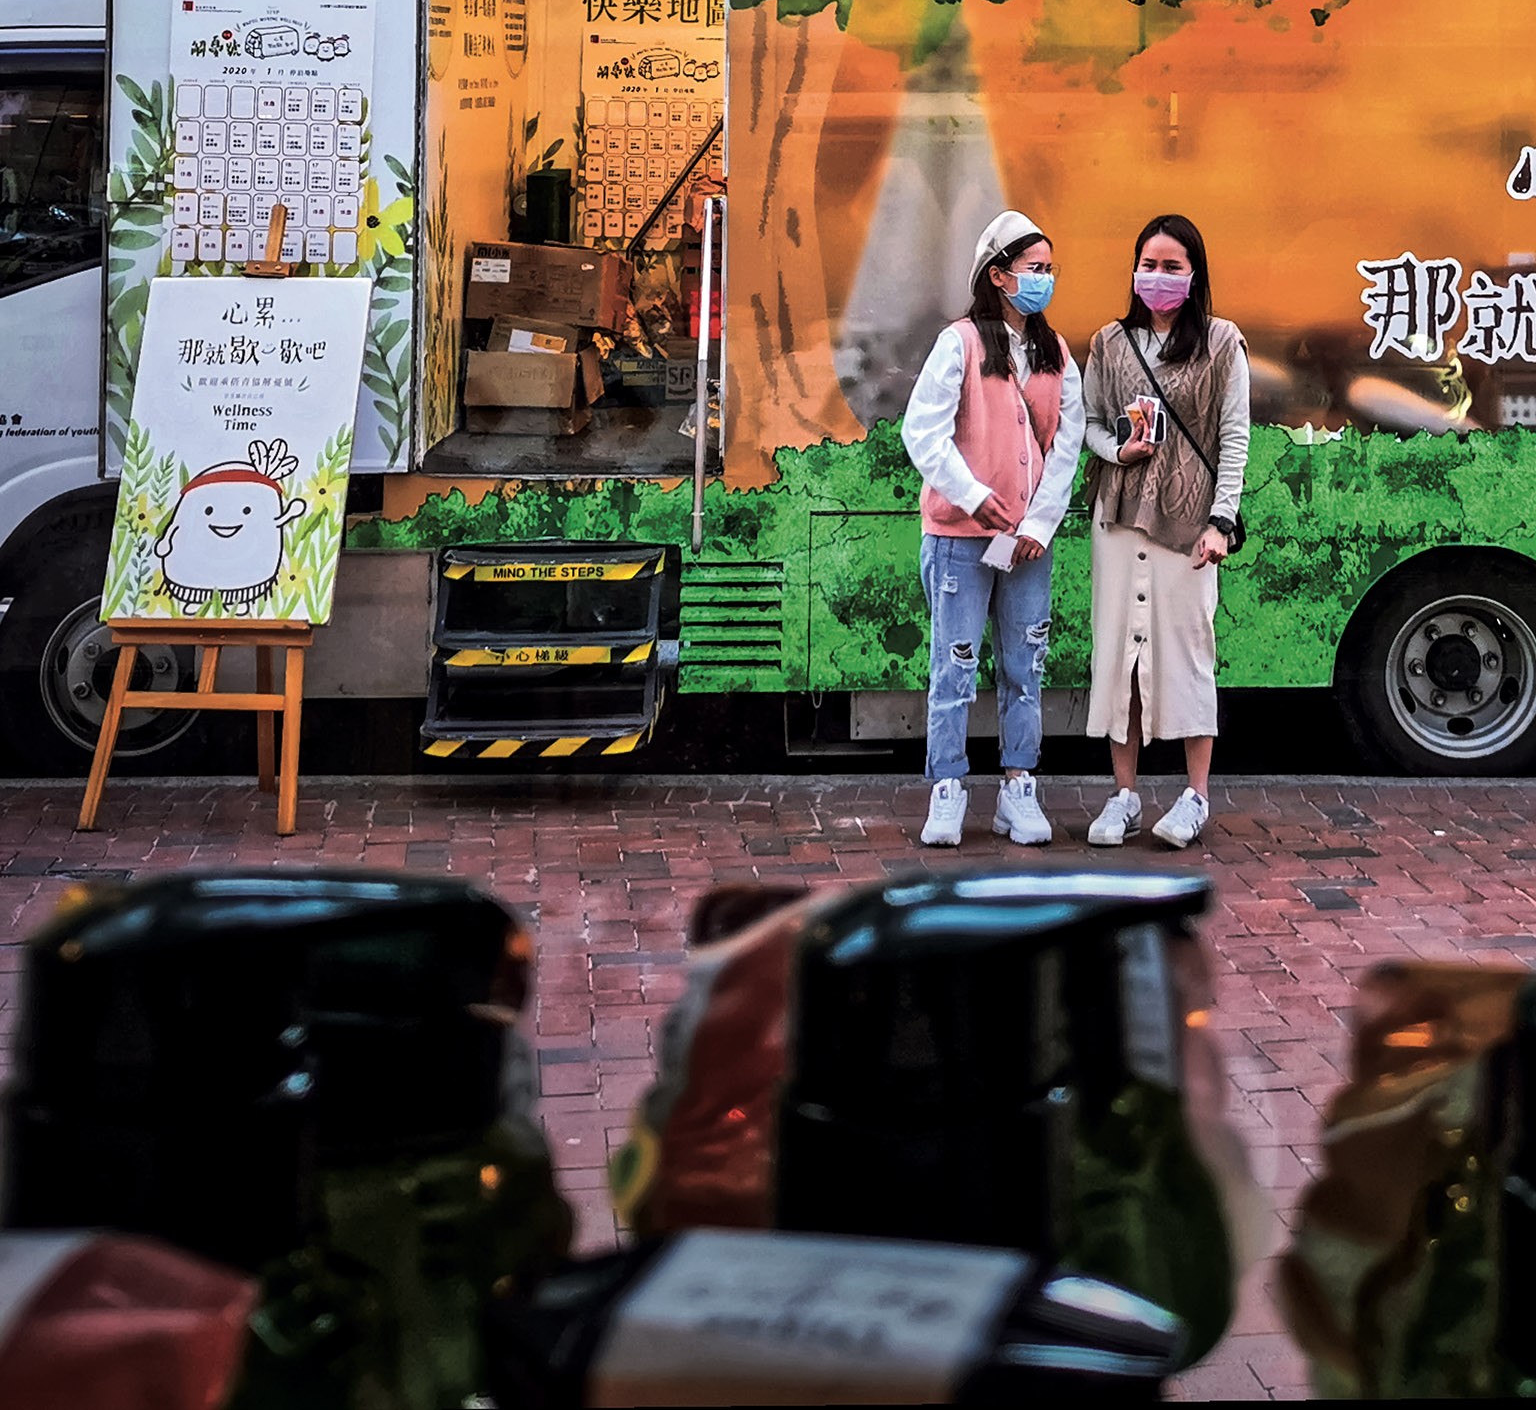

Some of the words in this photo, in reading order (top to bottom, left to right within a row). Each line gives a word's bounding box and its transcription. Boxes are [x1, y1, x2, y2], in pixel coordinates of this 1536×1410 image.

[222, 66, 247, 74] 2020
[213, 404, 273, 417] Wellness
[224, 419, 257, 431] Time
[6, 428, 56, 437] federation
[59, 426, 70, 436] of
[493, 567, 526, 579] MIND
[530, 566, 556, 578] THE
[560, 566, 604, 578] STEPS
